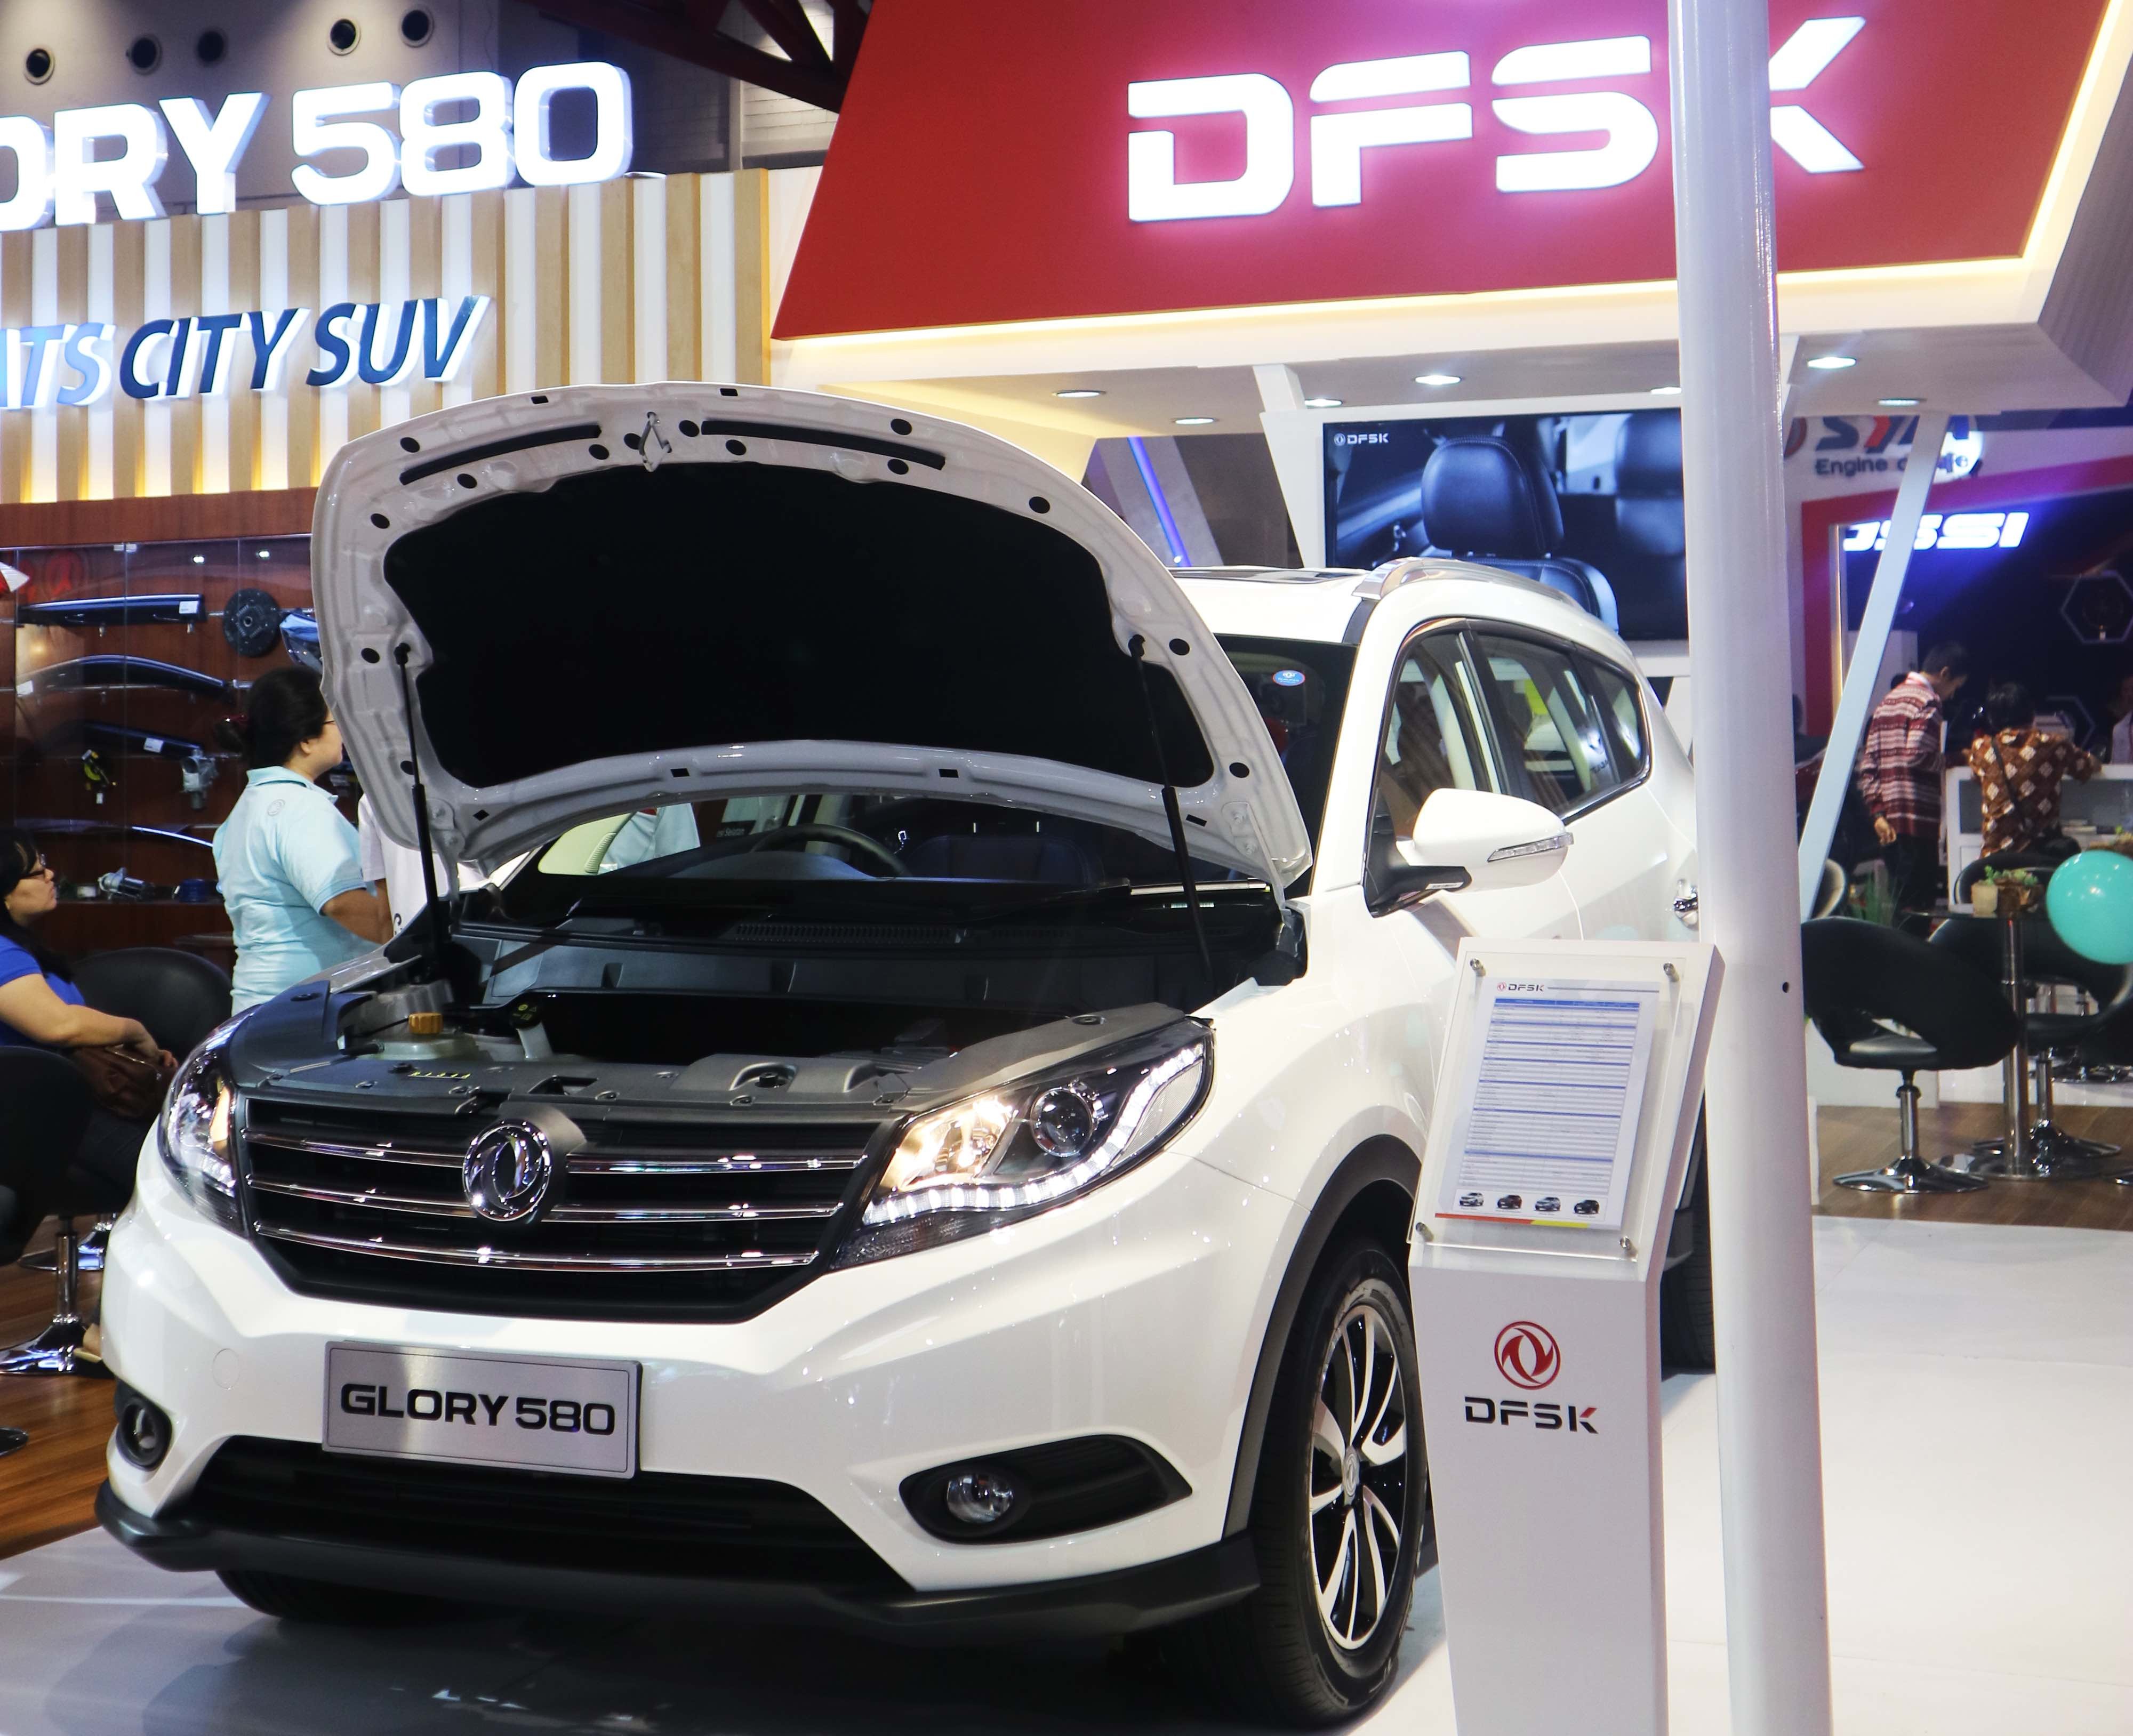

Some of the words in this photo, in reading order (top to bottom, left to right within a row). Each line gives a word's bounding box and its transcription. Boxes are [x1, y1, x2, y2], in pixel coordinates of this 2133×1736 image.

[291, 61, 633, 205] 580
[1128, 16, 1866, 222] DFSK
[119, 308, 311, 400] CITY
[307, 295, 493, 388] SUV
[1347, 433, 1389, 444] DFSK
[1815, 457, 1889, 477] Engine
[341, 1384, 509, 1426] GLORY
[515, 1397, 615, 1436] 580
[1464, 1396, 1599, 1434] DFSK
